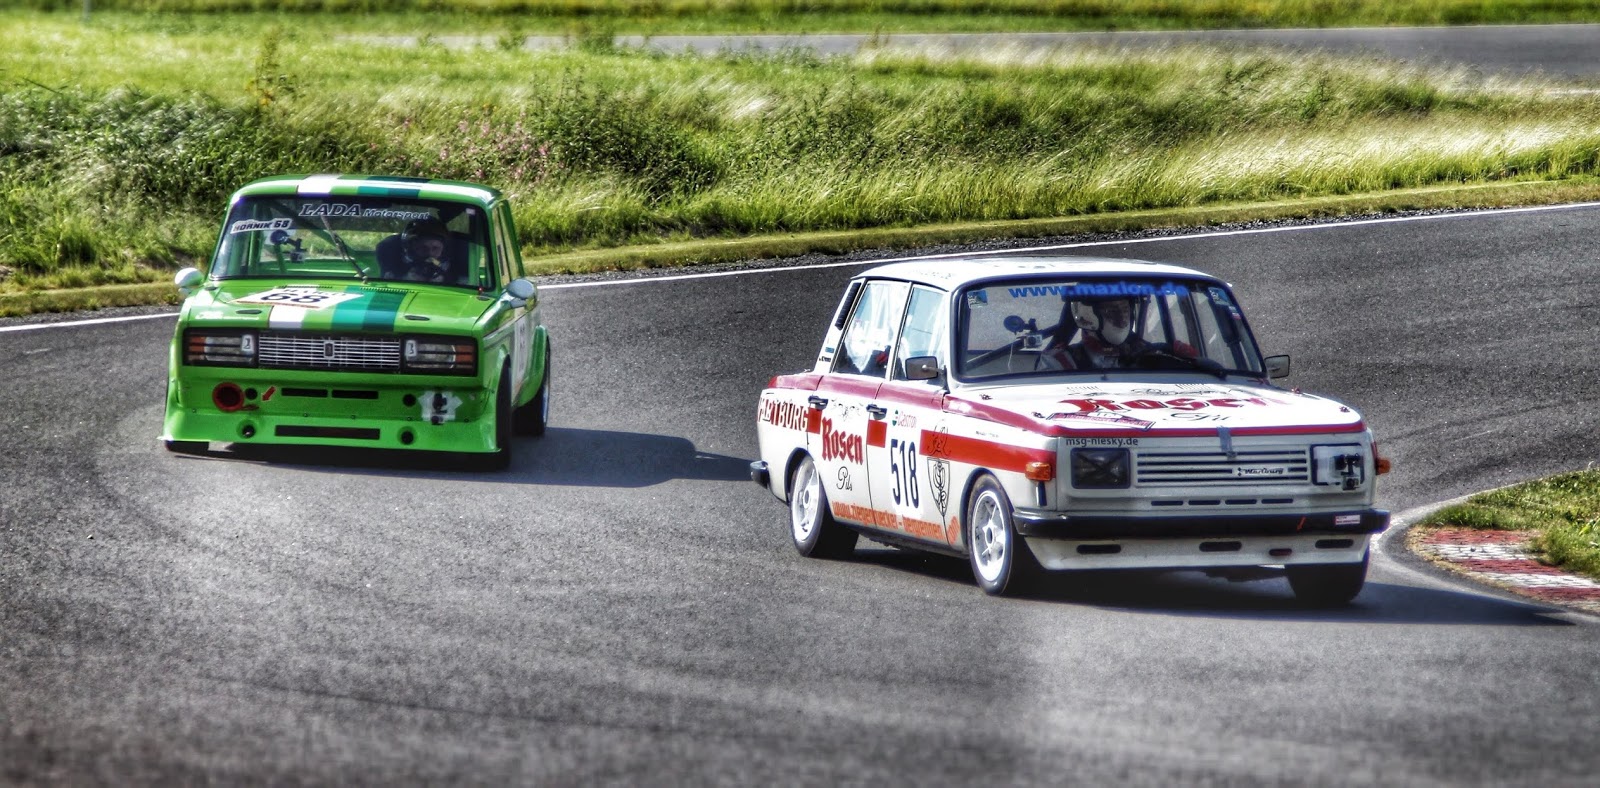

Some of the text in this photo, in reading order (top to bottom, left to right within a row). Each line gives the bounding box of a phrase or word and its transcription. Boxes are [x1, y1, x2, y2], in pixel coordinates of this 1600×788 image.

[299, 203, 429, 220] LADA Motorsport
[233, 221, 272, 232] HORNIK
[261, 292, 329, 304] 68
[1163, 412, 1246, 422] Pil
[821, 417, 863, 465] Rosen
[1066, 437, 1139, 448] msg-niesky.de
[836, 466, 853, 492] Pils
[891, 438, 919, 509] 518
